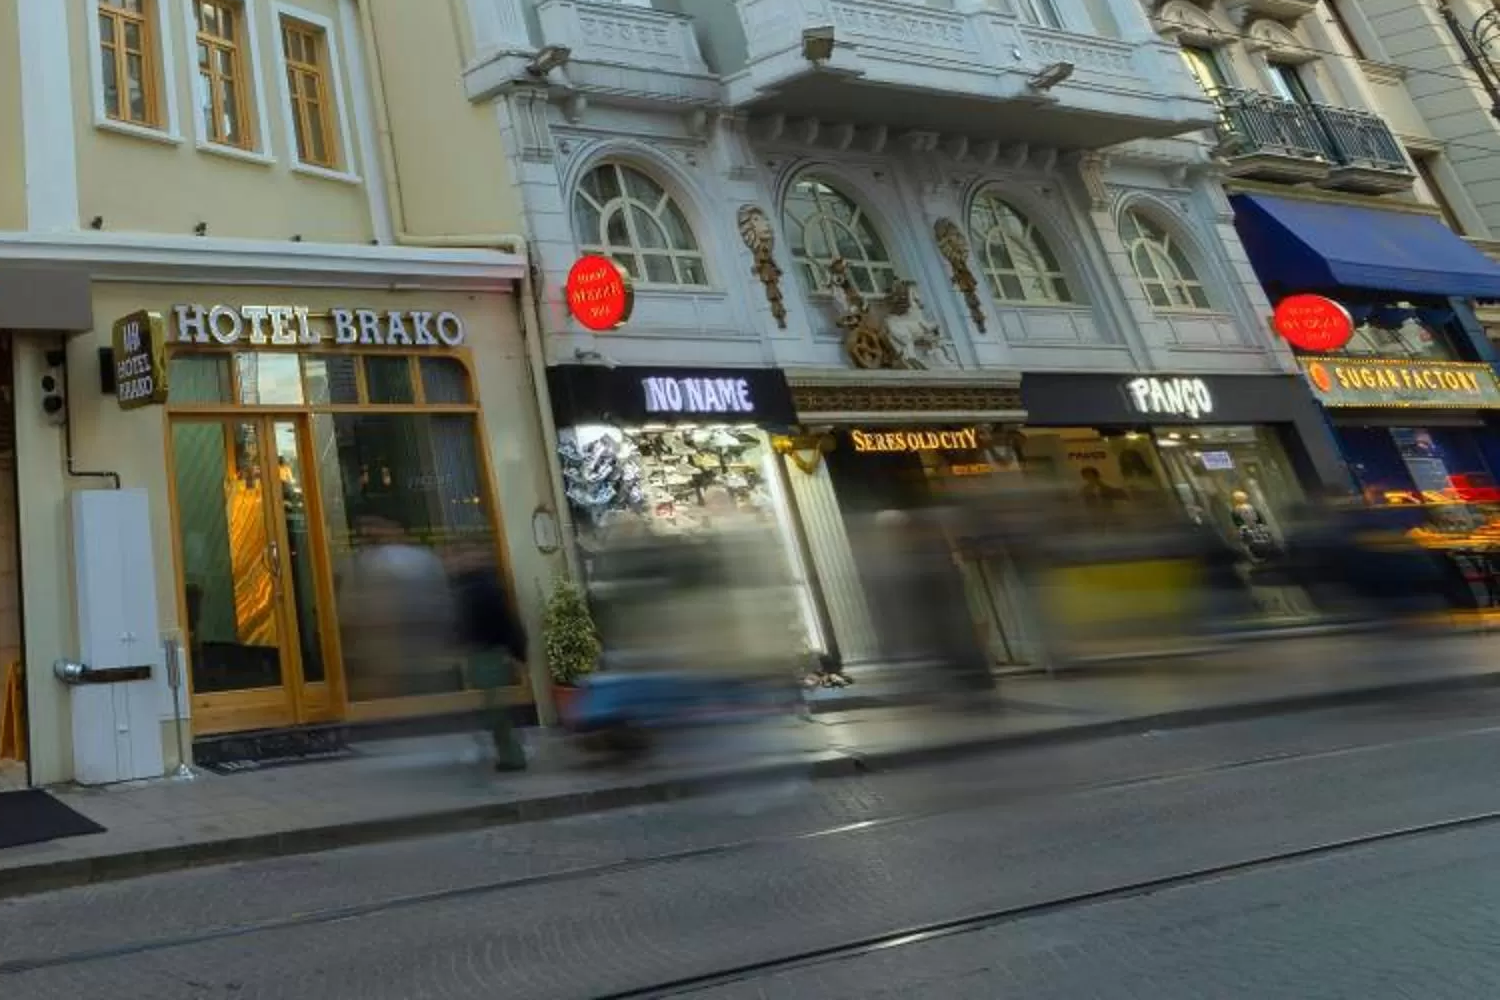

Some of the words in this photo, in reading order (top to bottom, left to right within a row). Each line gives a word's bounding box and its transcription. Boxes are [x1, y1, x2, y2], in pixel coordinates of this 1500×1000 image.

[174, 304, 320, 344] HOTEL
[332, 307, 467, 345] BRAKO
[642, 376, 682, 412] NO
[682, 376, 755, 412] NAME
[1335, 366, 1401, 391] SUGAR
[1401, 368, 1480, 392] FACTORY
[907, 431, 940, 451] OLD
[941, 427, 978, 449] CITY
